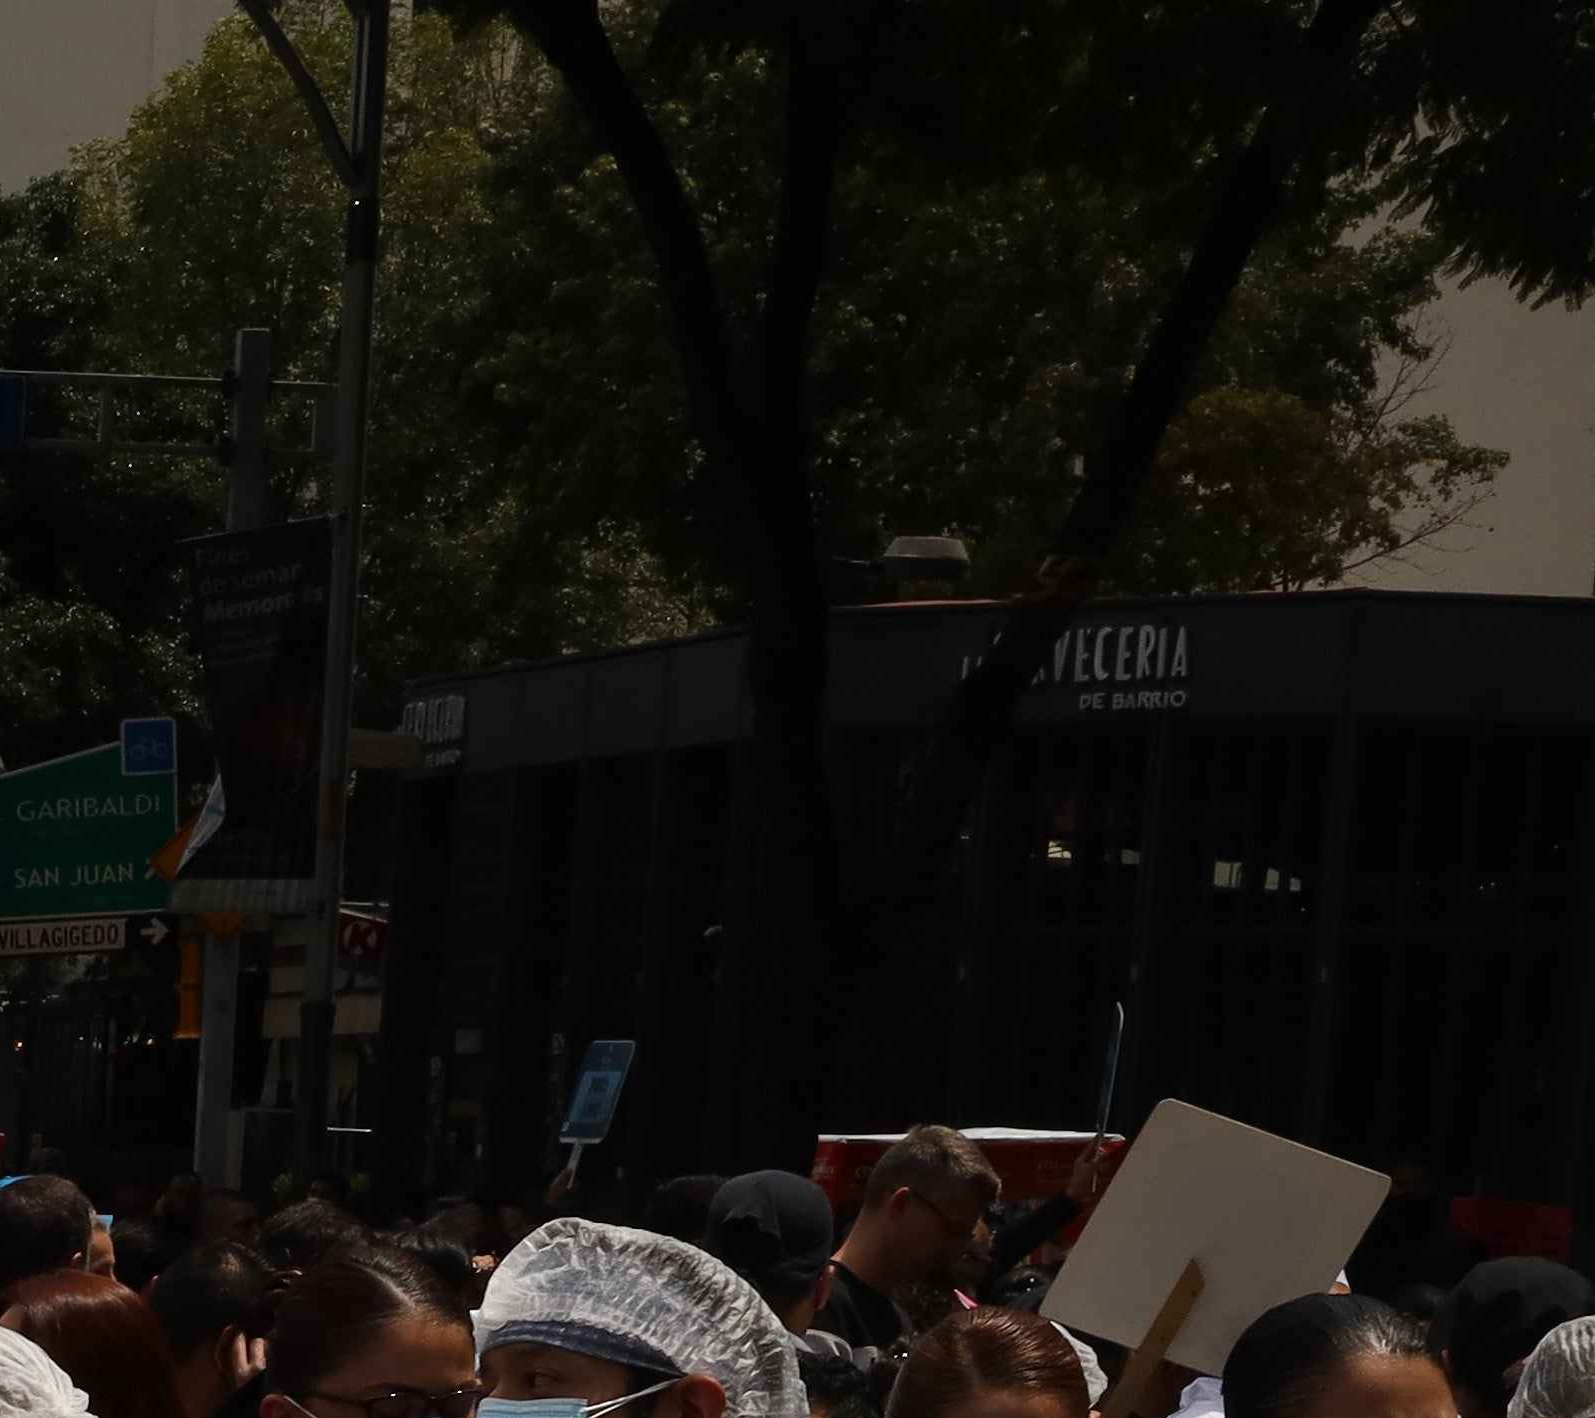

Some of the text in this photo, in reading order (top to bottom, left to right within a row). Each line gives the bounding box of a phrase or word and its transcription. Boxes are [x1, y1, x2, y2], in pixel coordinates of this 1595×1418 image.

[194, 546, 252, 568] Fines
[1079, 690, 1188, 710] DE BARRIO
[16, 793, 161, 821] GARIBALDI
[13, 862, 134, 888] SAN JUAN
